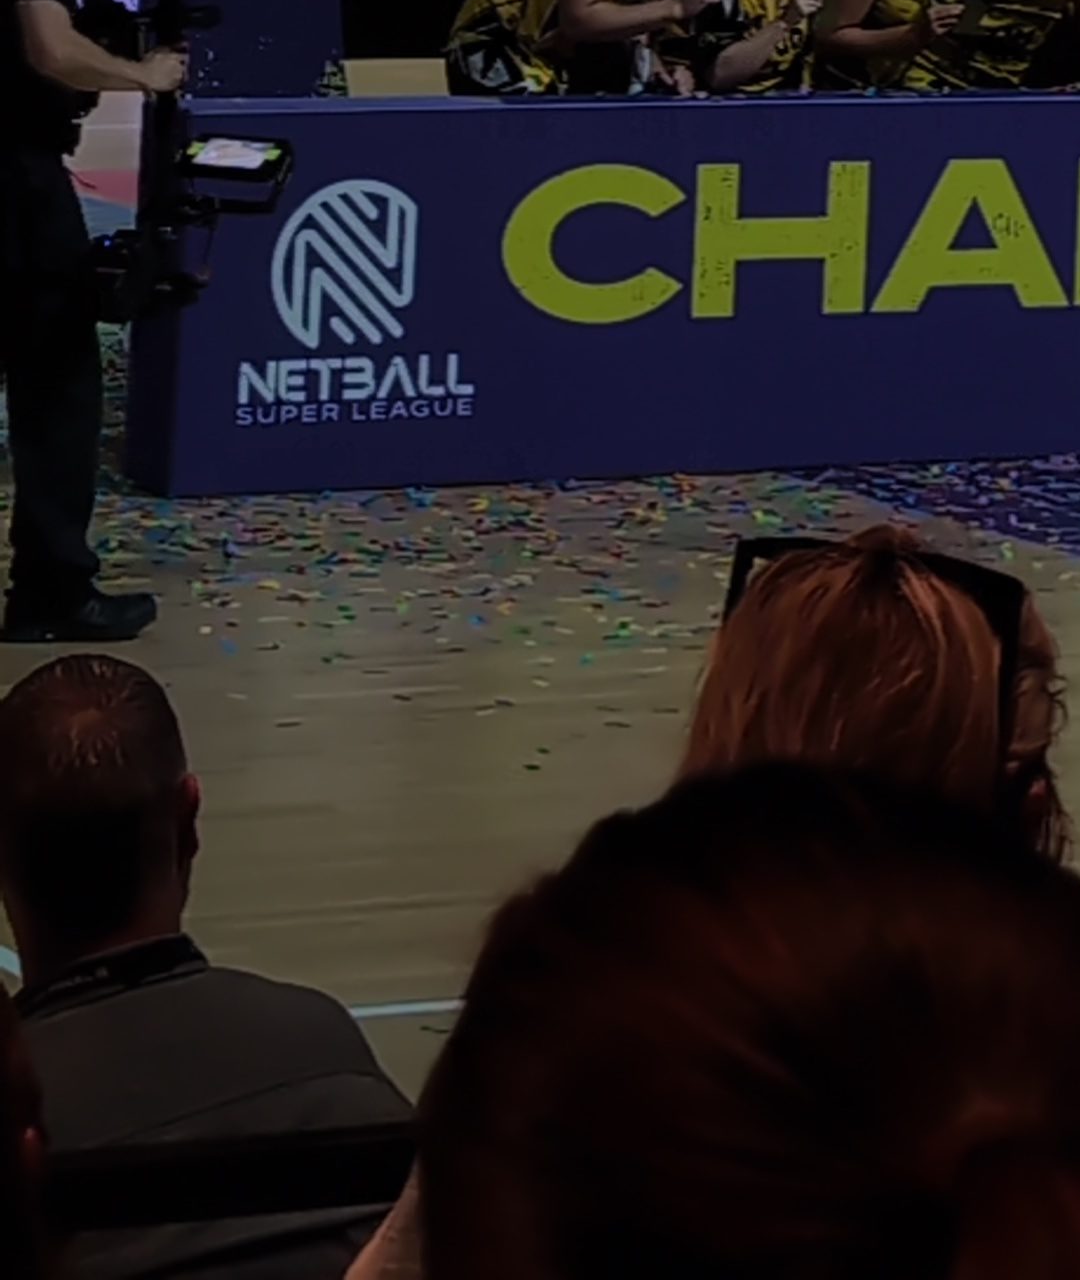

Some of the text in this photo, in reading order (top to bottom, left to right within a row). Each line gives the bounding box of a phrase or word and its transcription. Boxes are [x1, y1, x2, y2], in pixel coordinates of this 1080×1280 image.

[237, 352, 476, 405] NETBALL
[235, 397, 474, 426] SUPER LEAGUE
